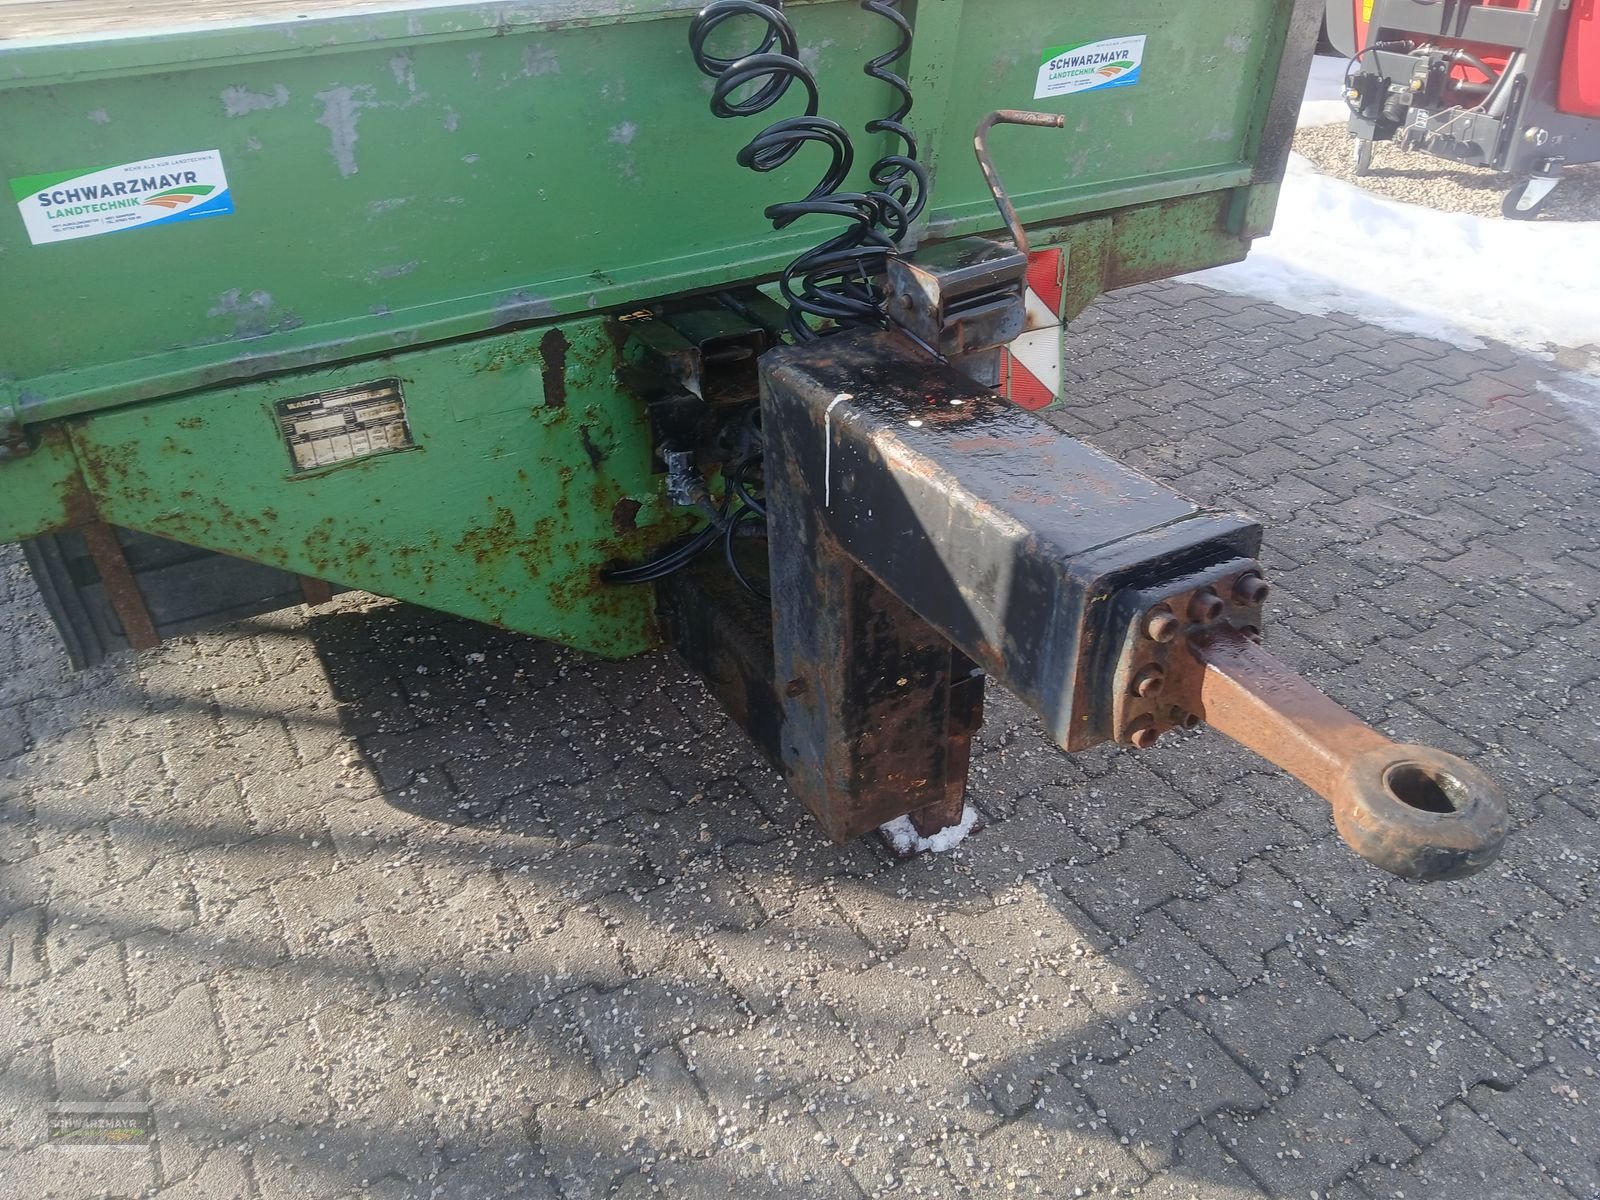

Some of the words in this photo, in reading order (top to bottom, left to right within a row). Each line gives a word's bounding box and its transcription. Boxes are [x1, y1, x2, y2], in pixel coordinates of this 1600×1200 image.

[1049, 49, 1129, 70] SCHWARZMAYR
[1048, 67, 1096, 80] LANDTECHNIK
[37, 170, 198, 207] SCHWARZMAYR
[46, 197, 141, 220] LANDTECHNIK
[286, 398, 321, 410] WABCO
